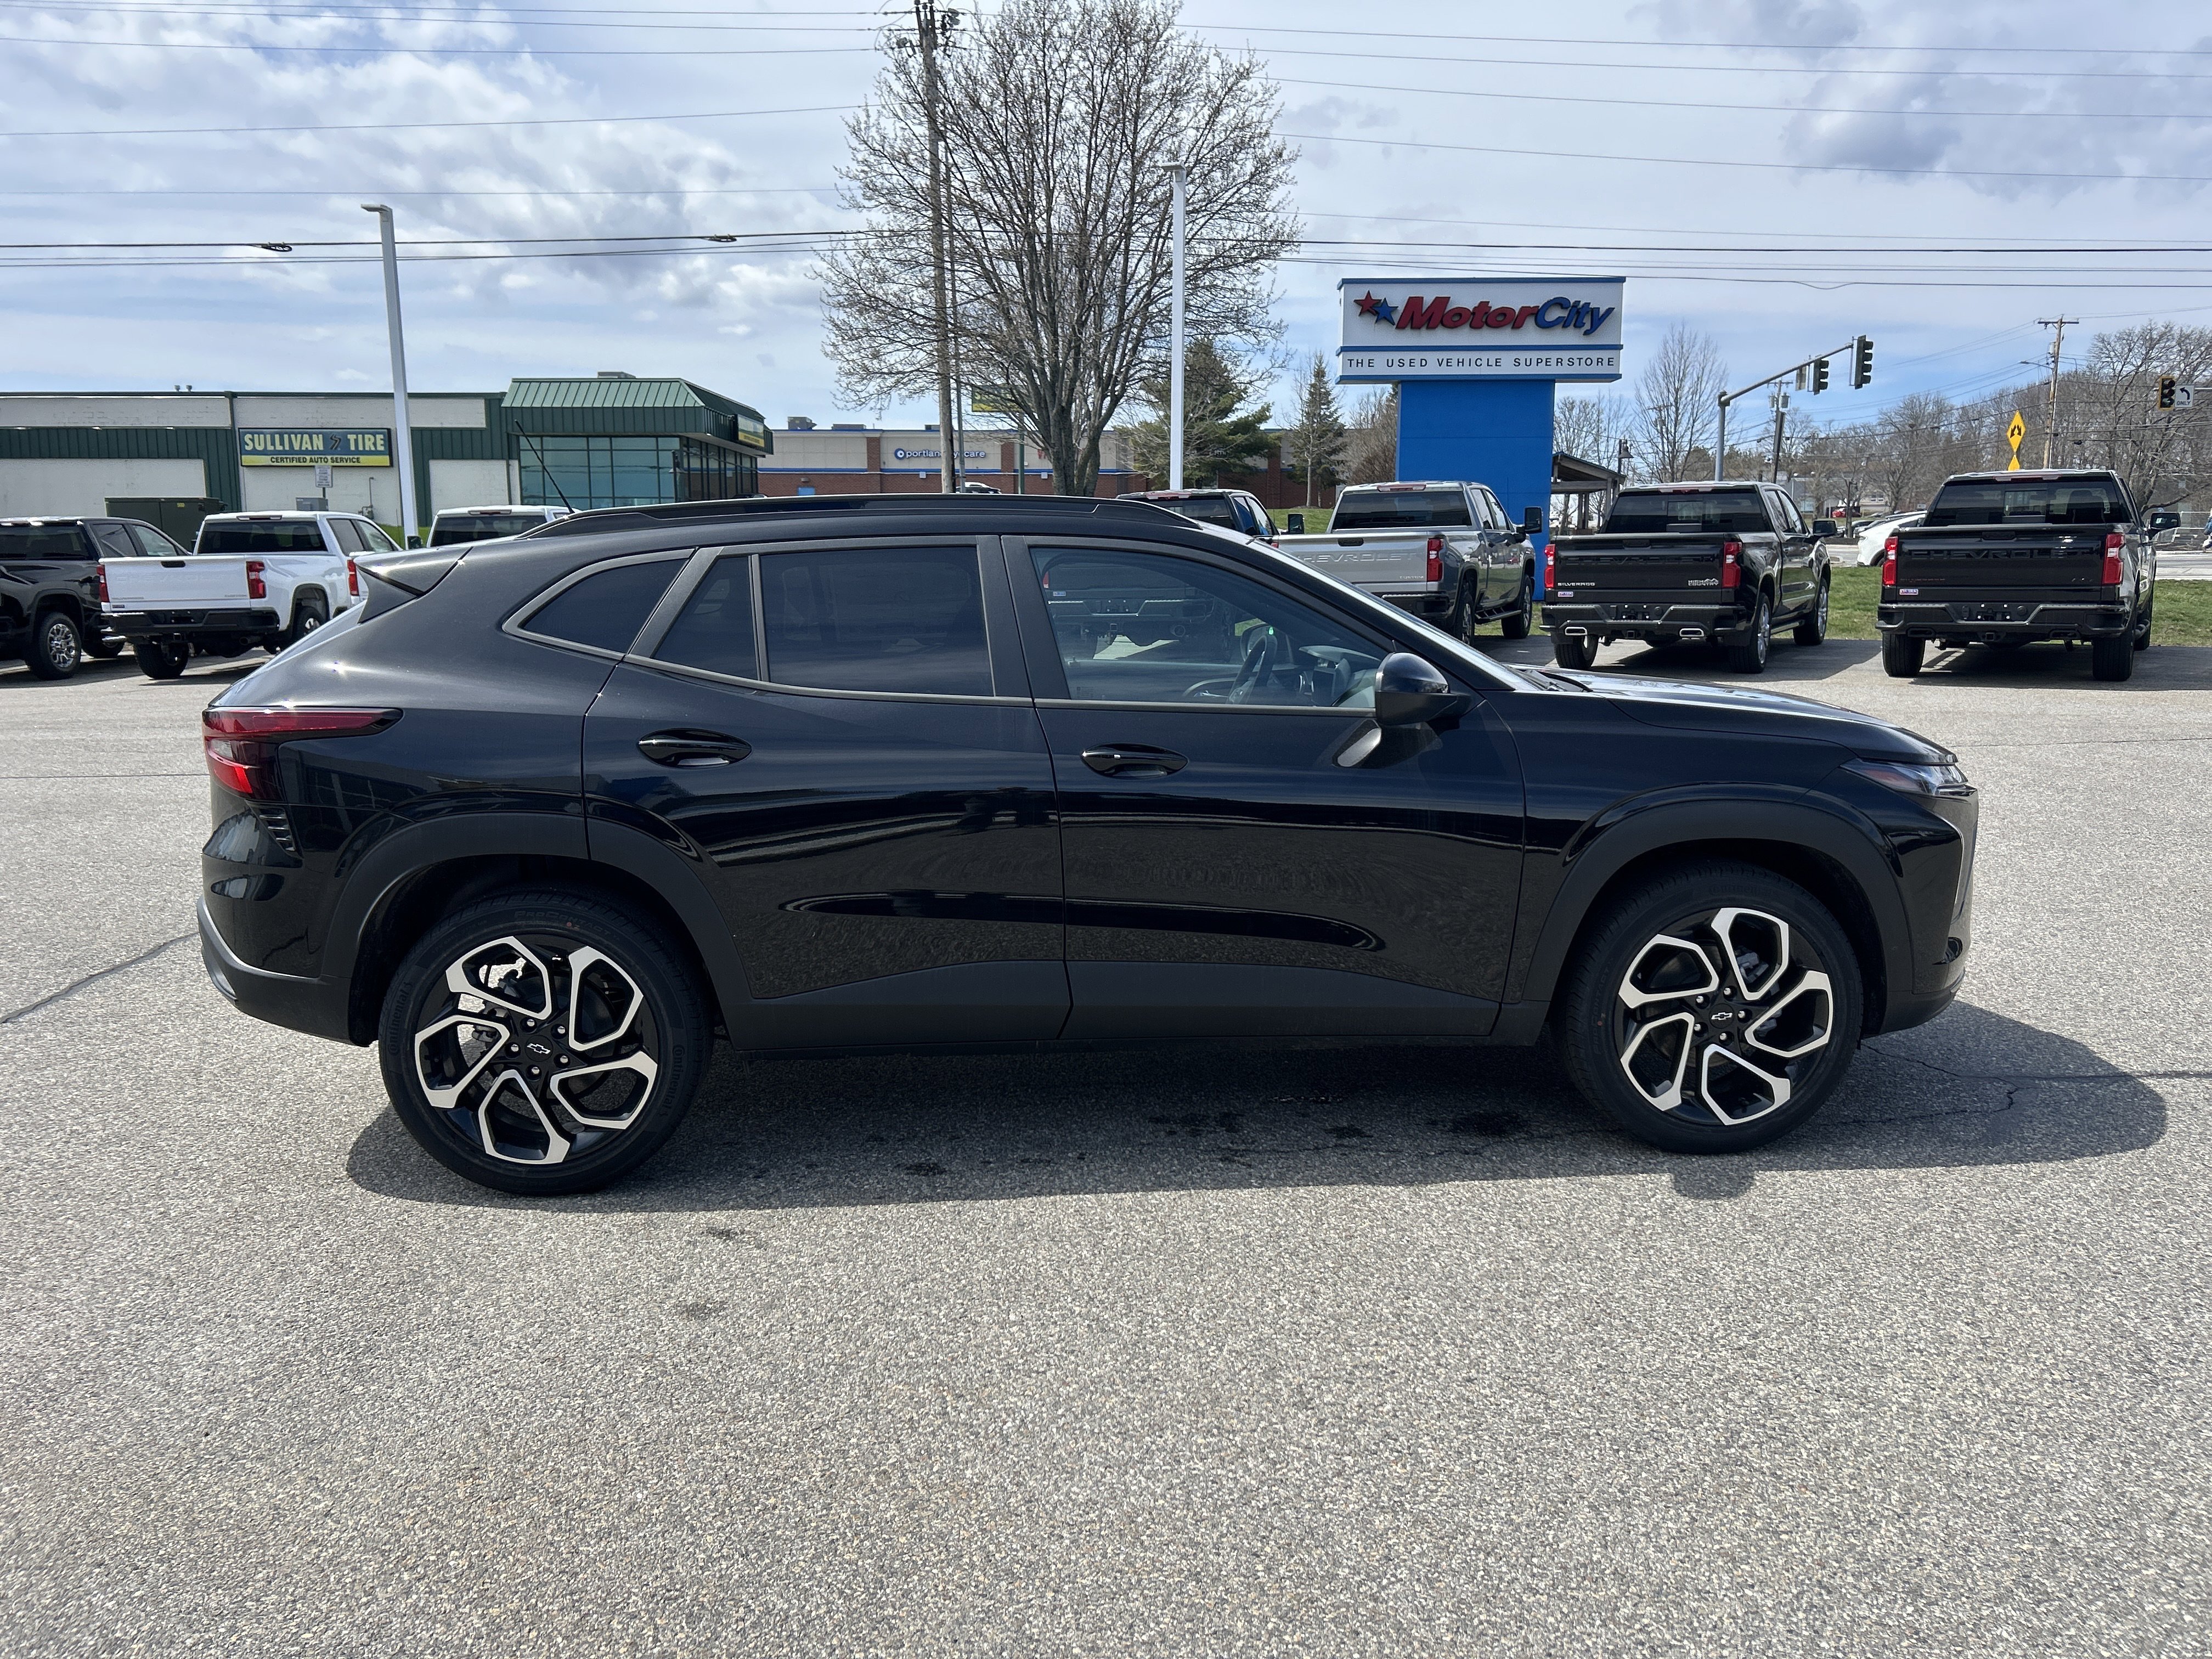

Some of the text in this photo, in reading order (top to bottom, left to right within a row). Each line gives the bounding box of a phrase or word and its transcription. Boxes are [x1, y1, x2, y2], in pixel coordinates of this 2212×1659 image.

[1395, 296, 1615, 335] MotorCity
[1347, 357, 1615, 368] THE USED VEHICLE SUPERSTORE
[244, 434, 385, 451] SULLIVAN TIRE
